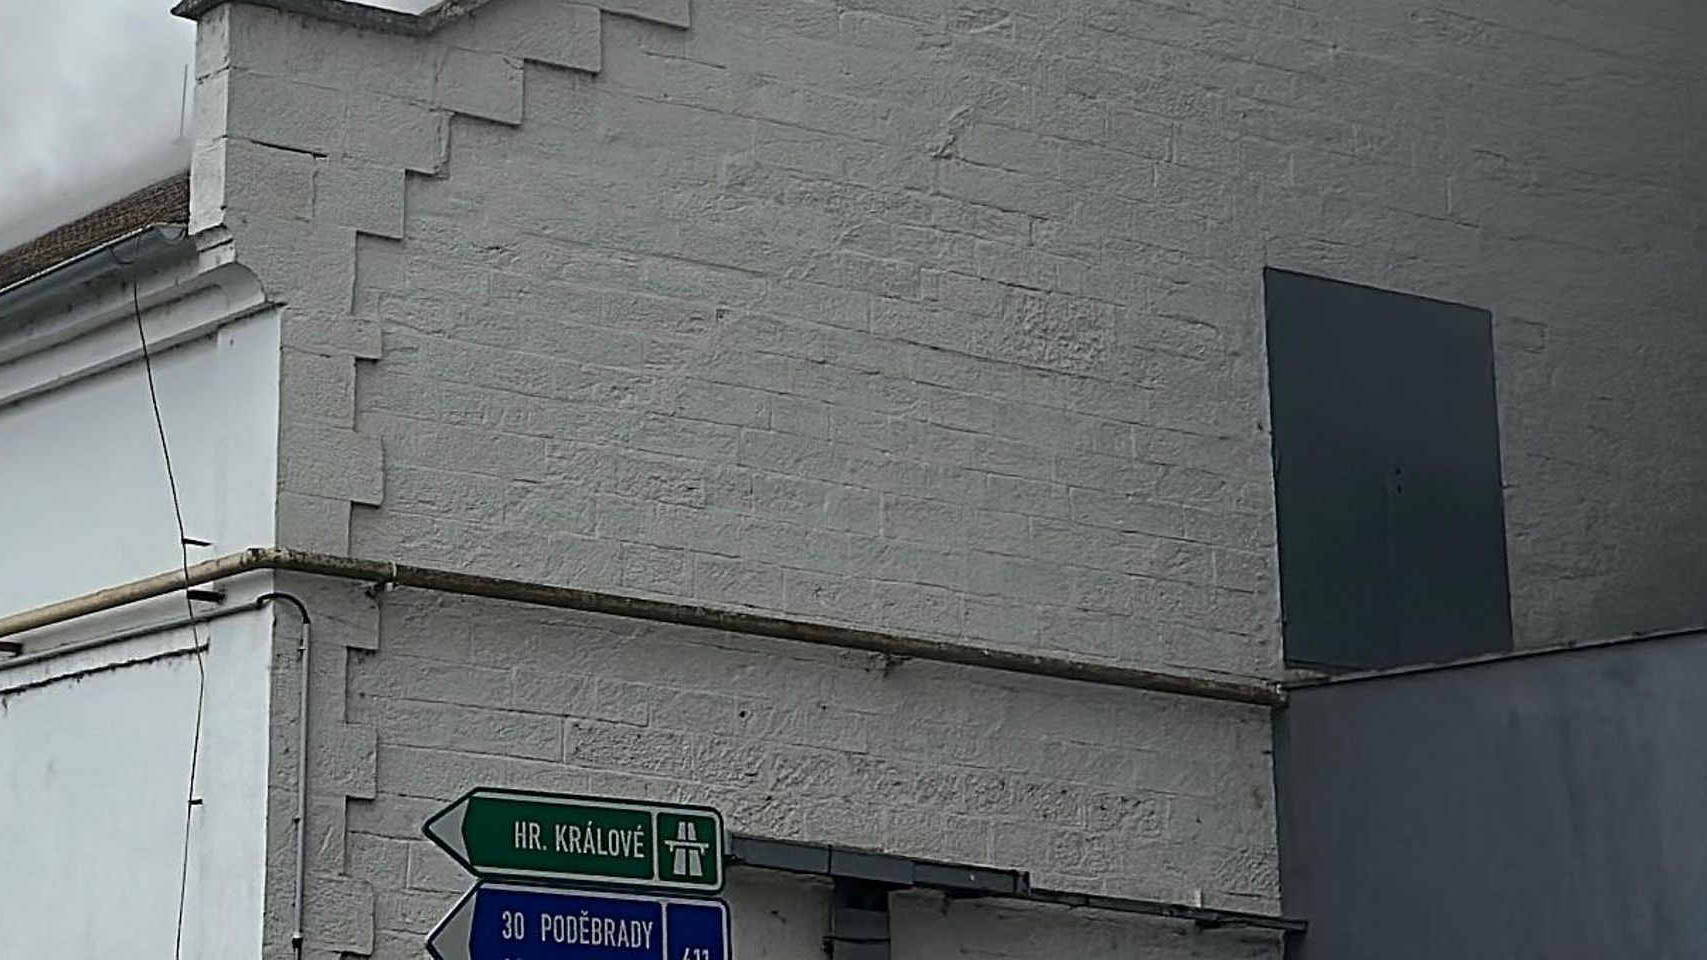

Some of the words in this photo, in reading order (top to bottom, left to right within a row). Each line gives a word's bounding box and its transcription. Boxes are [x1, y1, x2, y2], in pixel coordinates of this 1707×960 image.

[514, 821, 547, 851] HR.
[555, 820, 645, 857] KRÁLOVÉ
[502, 910, 525, 940] 30
[541, 910, 653, 949] PODĚBRADY
